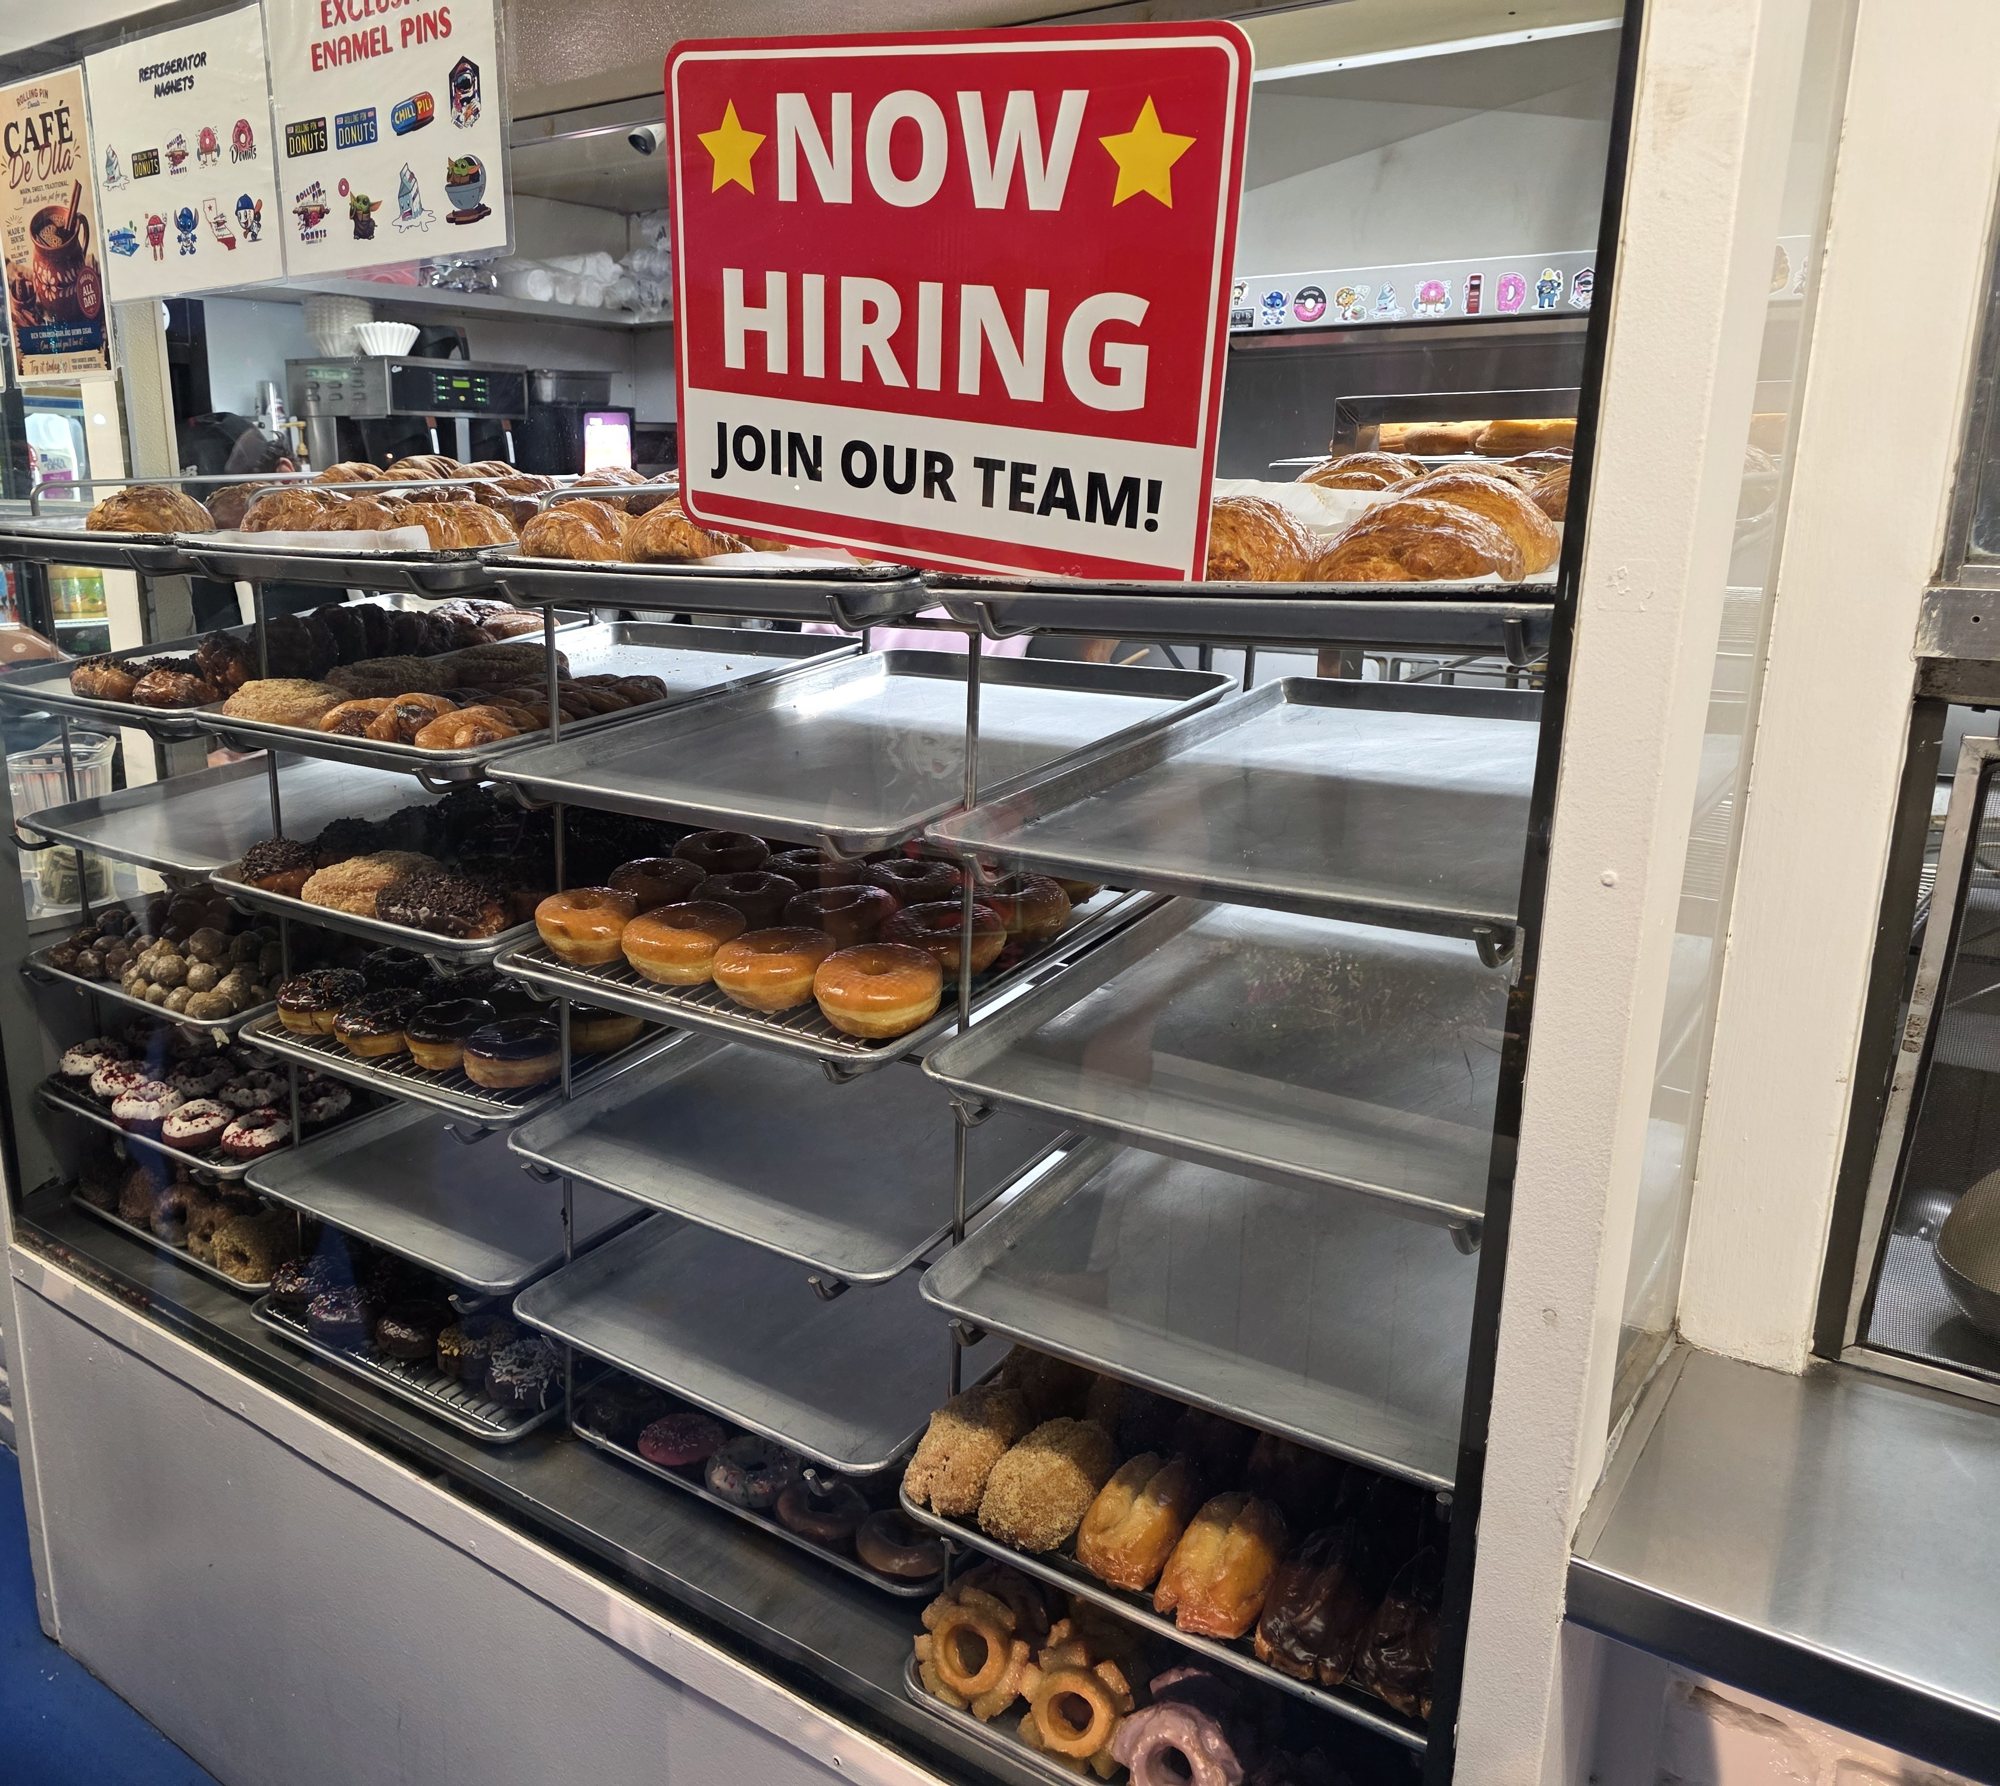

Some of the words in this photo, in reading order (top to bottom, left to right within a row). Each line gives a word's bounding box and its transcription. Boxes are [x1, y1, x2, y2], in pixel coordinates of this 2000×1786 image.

[320, 0, 420, 29] EXCL
[310, 25, 394, 72] ENAMEL
[400, 6, 452, 49] PINS
[138, 51, 207, 83] REFRIGERATOR
[16, 88, 39, 107] ROLLING
[39, 88, 49, 99] PIN
[154, 74, 195, 98] MAGNETS
[394, 104, 416, 124] CHILL
[417, 98, 433, 114] PILL
[4, 100, 73, 157] CAFÉ
[338, 121, 376, 147] DONUTS
[229, 144, 257, 164] Donuts
[288, 131, 326, 155] DONUTS
[776, 89, 1090, 211] NOW
[8, 153, 33, 189] De
[37, 140, 75, 180] Olla
[134, 158, 159, 177] DONUTS
[295, 180, 320, 203] ROLLING
[300, 229, 327, 241] DONUTS
[83, 283, 95, 297] ALL
[722, 267, 1151, 412] HIRING
[710, 421, 822, 482] JOIN
[841, 439, 958, 502] OUR
[973, 456, 1163, 533] TEAM!
